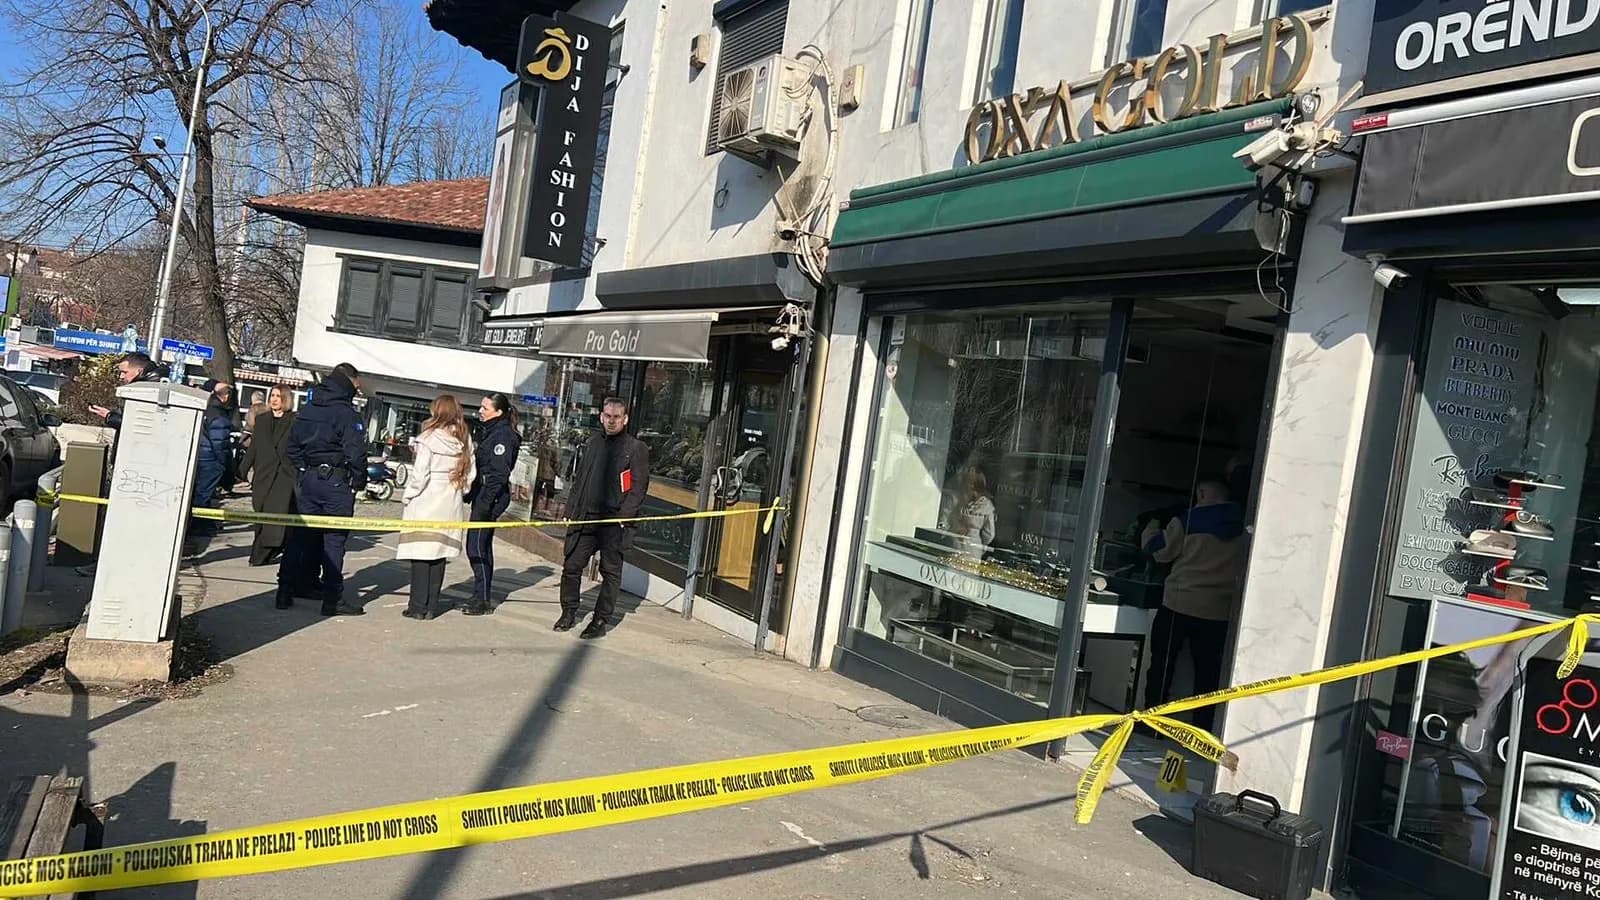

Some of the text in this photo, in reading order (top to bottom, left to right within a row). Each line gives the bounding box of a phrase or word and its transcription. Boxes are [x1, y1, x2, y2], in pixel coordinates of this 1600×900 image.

[964, 15, 1314, 166] OXA GOLD
[548, 33, 590, 248] DIJA FASHION
[1462, 313, 1520, 336] VOGUE
[584, 329, 640, 353] Pro Gold
[1451, 355, 1515, 381] PRADA
[1446, 378, 1514, 404] BURBERRY
[1436, 400, 1509, 424] MONT BLANC
[1448, 424, 1501, 446] GUCCI
[920, 564, 992, 600] OXA GOLD
[1400, 574, 1468, 596] BVLGA
[829, 759, 855, 777] SHIRITI
[859, 752, 889, 773] POLICISË
[886, 753, 904, 769] MOS
[901, 750, 927, 767] KALONI
[1161, 755, 1179, 783] 10
[461, 806, 498, 830] SHIRITI
[503, 798, 544, 825] POLICISË
[543, 798, 565, 819] MOS
[565, 794, 597, 816] KALONI
[601, 787, 650, 811] POLICIJSKA
[649, 783, 676, 804] TRAKA
[675, 782, 687, 800] NE
[686, 777, 718, 799] PRELAZI
[721, 774, 748, 793] POLICE
[749, 771, 764, 789] LINE
[763, 770, 774, 786] DO
[774, 768, 789, 785] NOT
[789, 764, 815, 784] CROSS
[36, 857, 64, 882] MOS
[67, 852, 113, 879] KALONI
[123, 844, 193, 873] POLICIJSKA
[195, 839, 233, 864] TRAKA
[236, 837, 250, 859] NE
[252, 831, 296, 857] PRELAZI
[305, 825, 342, 850] POLICE
[343, 822, 365, 845] LINE
[367, 820, 382, 842] DO
[383, 817, 403, 840] NOT
[404, 814, 438, 837] CROSS
[1540, 843, 1582, 864] Bëjmë
[1513, 853, 1523, 862] e
[1525, 855, 1580, 878] dioptrisë
[1514, 866, 1530, 878] në
[1533, 871, 1582, 892] mënyrë
